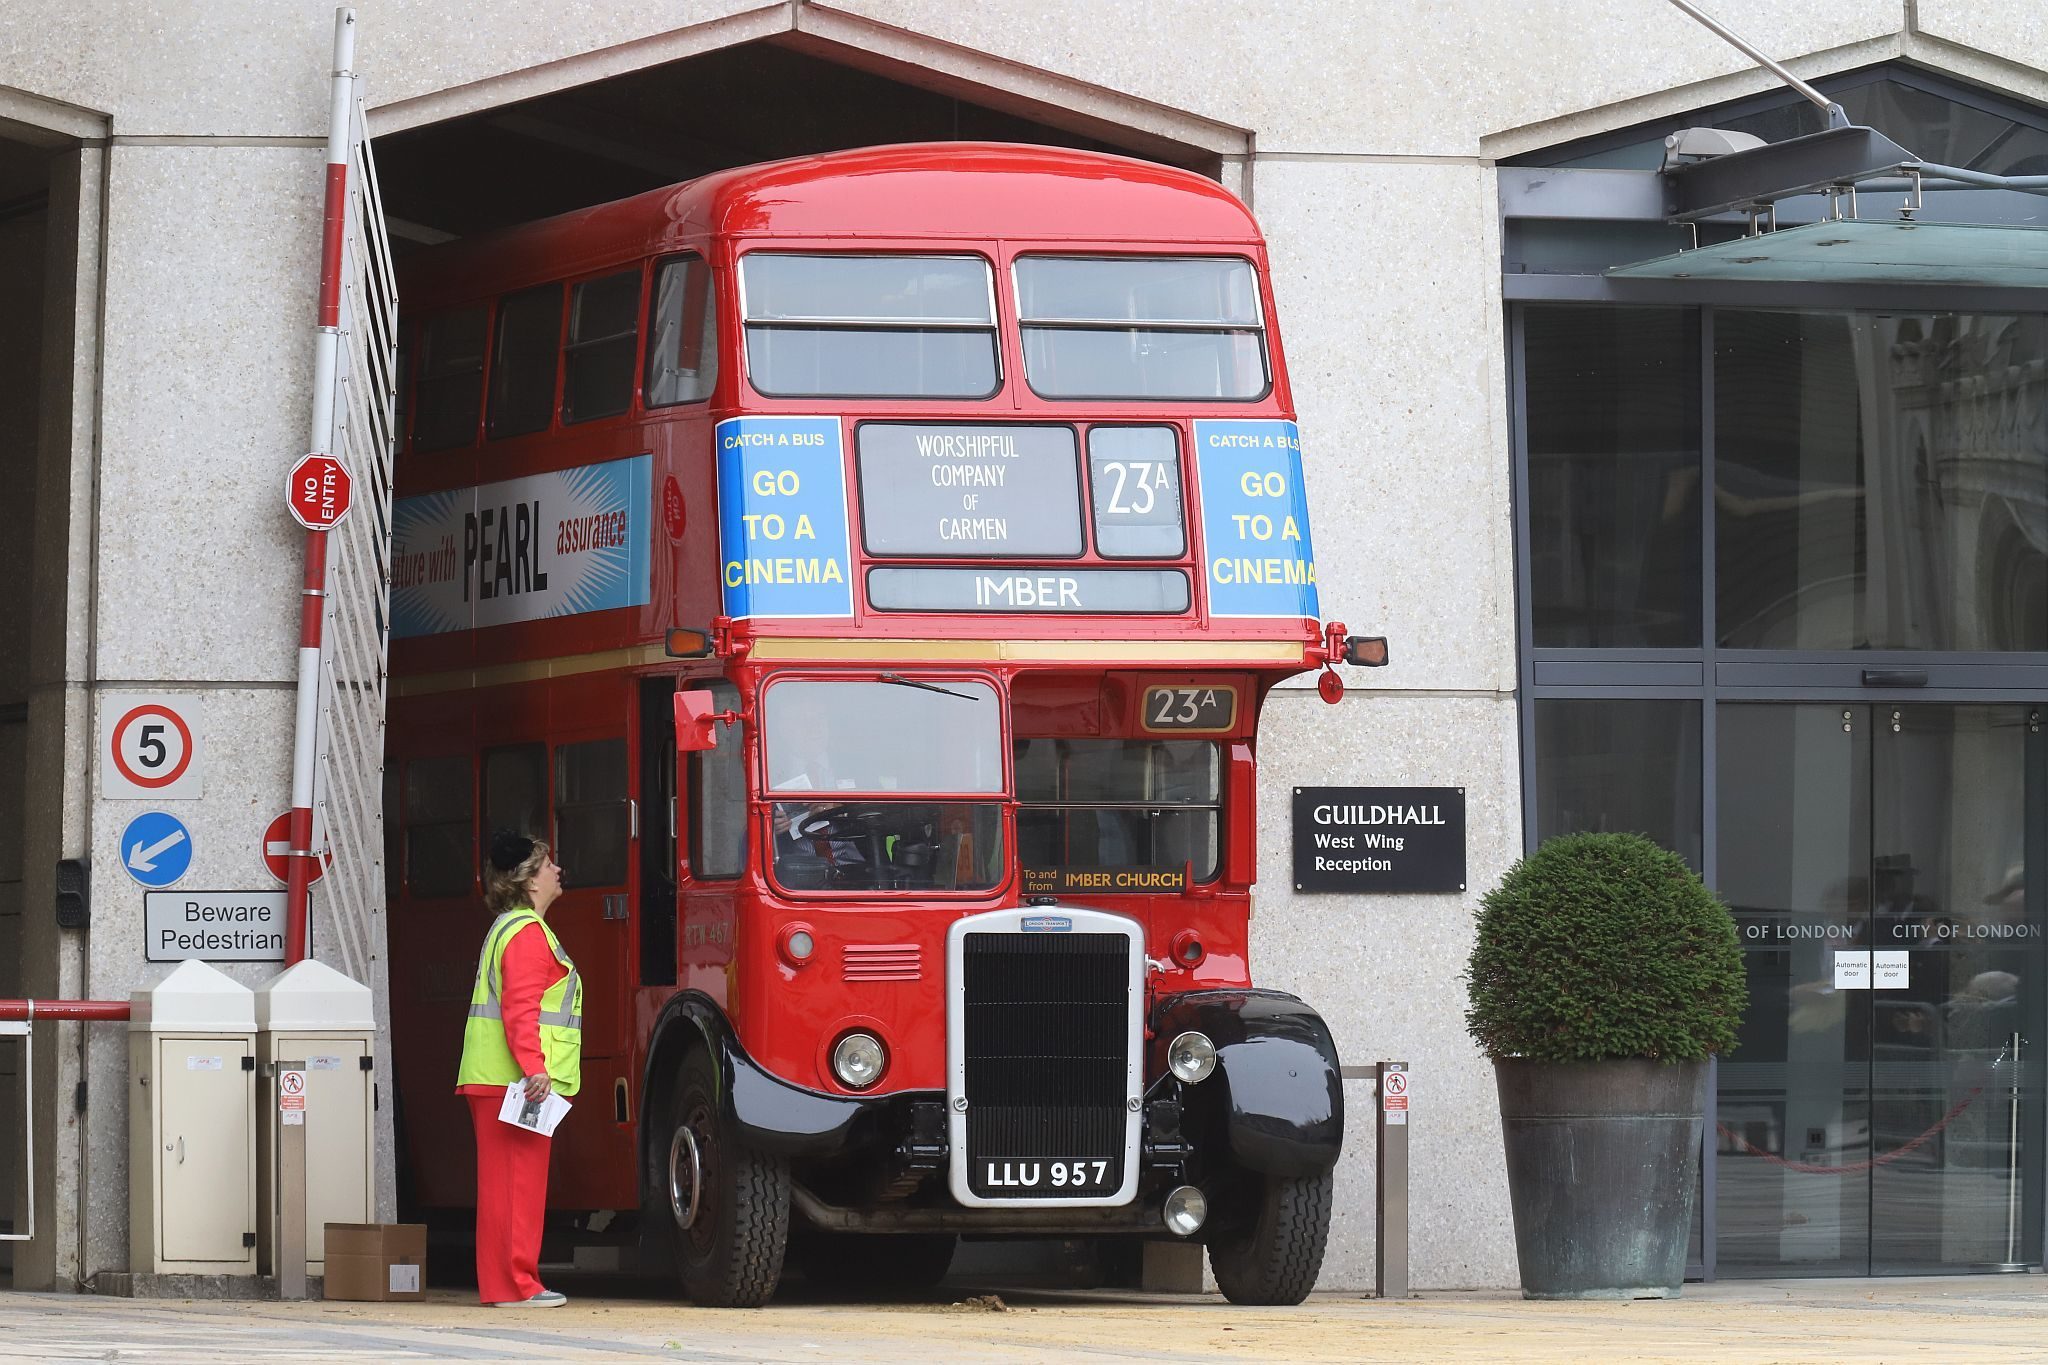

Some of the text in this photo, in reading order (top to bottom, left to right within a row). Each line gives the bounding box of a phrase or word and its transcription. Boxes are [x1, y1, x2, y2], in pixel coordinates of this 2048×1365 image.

[724, 433, 825, 449] CATCH A BUS
[916, 434, 1019, 458] WORSHIPFUL
[1209, 434, 1299, 451] CATCH A BUS
[753, 470, 800, 497] GO
[932, 464, 1006, 487] COMPANY
[1240, 471, 1286, 498] GO
[304, 477, 318, 503] NO
[321, 462, 337, 520] ENTRY
[1103, 461, 1170, 515] 23A
[963, 494, 979, 511] OF
[742, 513, 816, 541] TO A
[939, 518, 1008, 540] CARMEN
[1231, 514, 1301, 541] TO A
[390, 500, 626, 603] uture with PEARL assurance
[725, 558, 844, 588] CINEMA
[1212, 557, 1317, 586] CINEMA
[974, 575, 1082, 608] IMBER
[1153, 688, 1218, 724] 23A
[138, 724, 167, 769] 5
[1313, 805, 1446, 825] GUILDHALL
[1314, 833, 1405, 851] West Wing
[1024, 869, 1057, 879] To and
[1315, 856, 1392, 874] Reception
[1028, 881, 1053, 891] from
[1065, 873, 1183, 887] IMBER CHURCH
[185, 901, 272, 922] Beware
[161, 929, 286, 951] Pedestrian
[1746, 925, 1769, 939] OF
[1776, 925, 1853, 939] LONDON
[1892, 924, 2041, 938] CITY OF LONDON
[1836, 961, 1868, 969] Automatic
[1876, 962, 1907, 970] Automatic
[987, 1161, 1107, 1187] LLU 957
